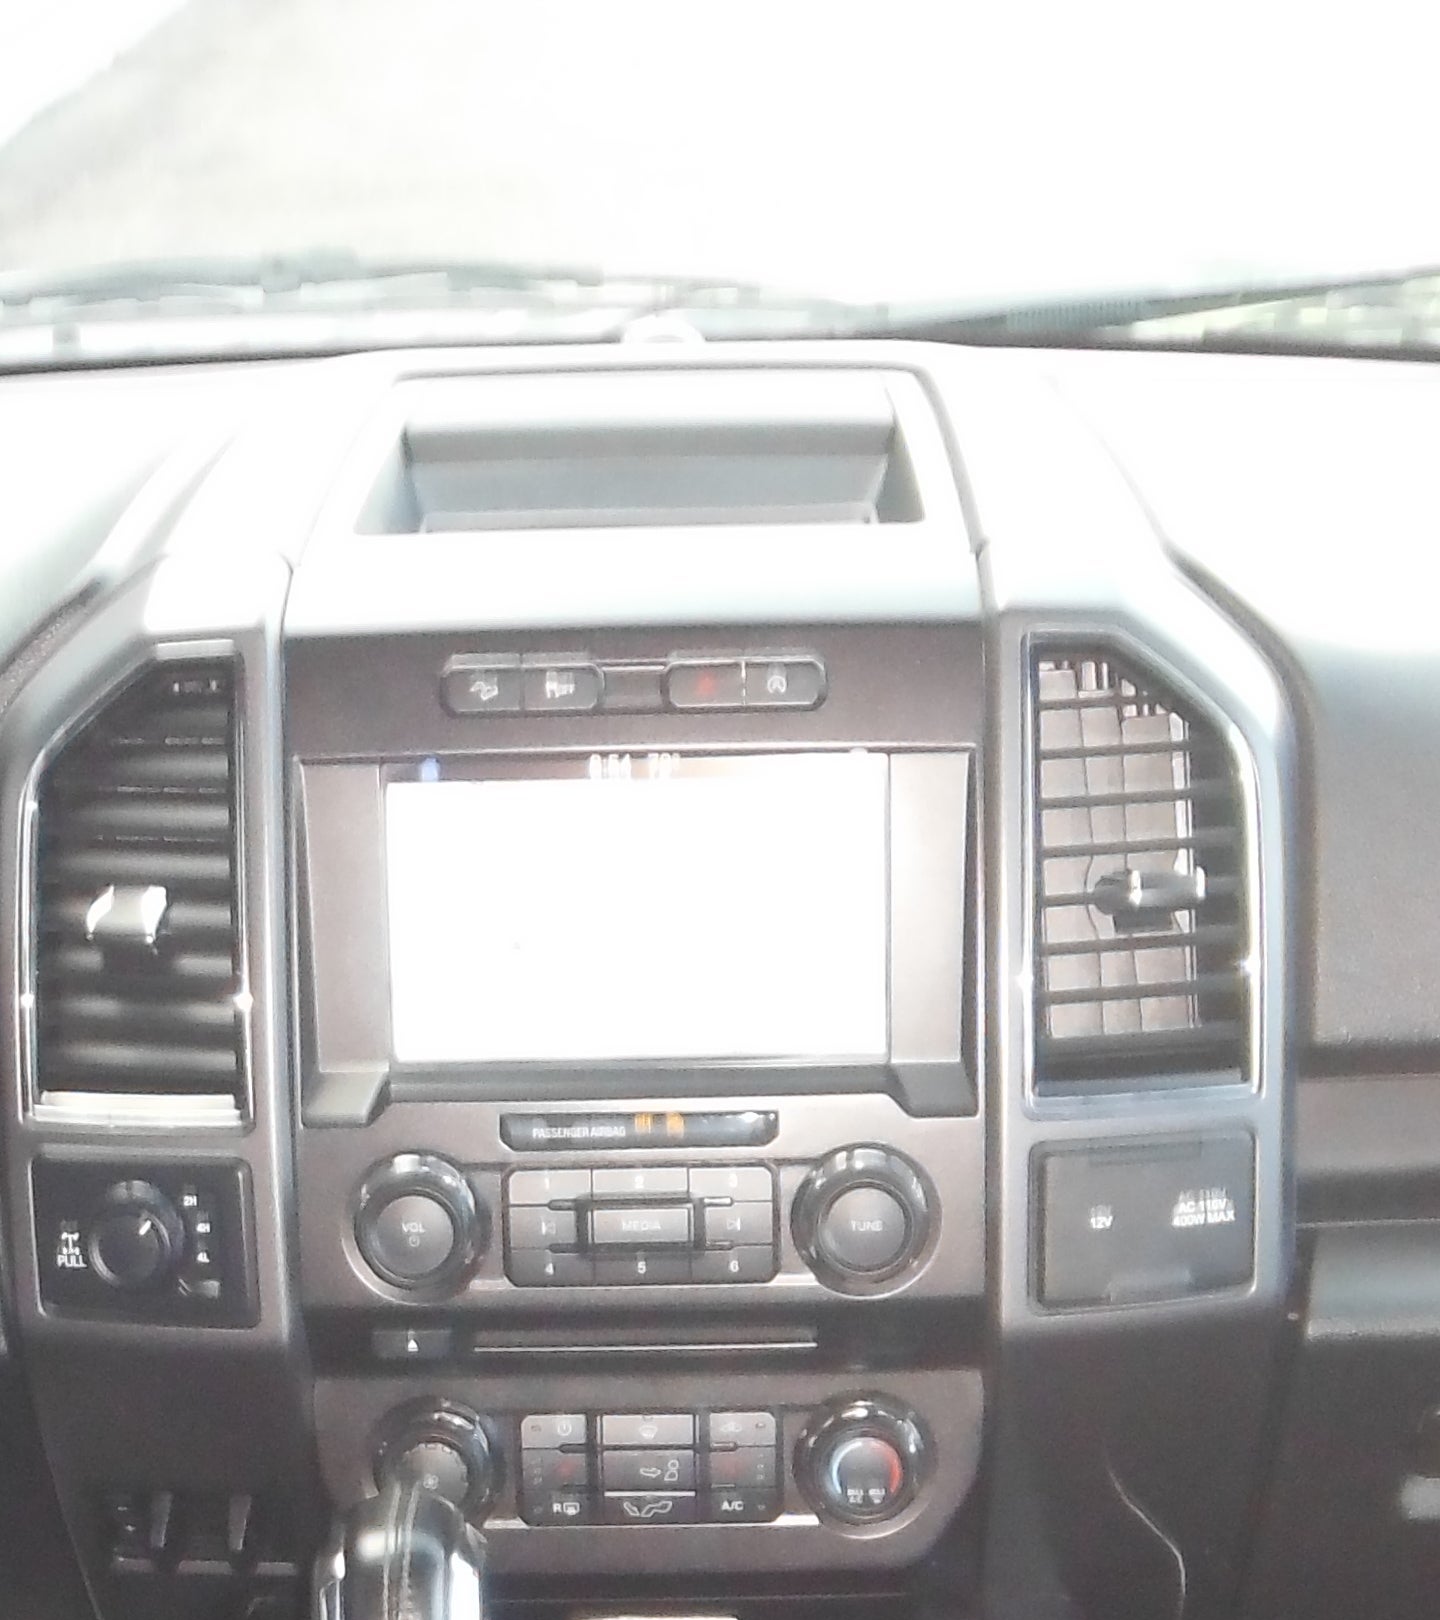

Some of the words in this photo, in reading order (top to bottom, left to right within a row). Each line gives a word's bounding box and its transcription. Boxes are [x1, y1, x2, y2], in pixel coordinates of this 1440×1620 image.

[532, 1127, 589, 1139] PASSENGER
[634, 1174, 645, 1189] 2
[1178, 1201, 1195, 1213] AC
[621, 1218, 662, 1231] MEDIA
[1090, 1215, 1113, 1229] 12V
[1172, 1213, 1205, 1227] 400W
[1207, 1210, 1235, 1223] MAX
[401, 1222, 426, 1233] VOL
[850, 1220, 883, 1231] TUNE
[57, 1255, 87, 1268] PULL
[637, 1261, 646, 1274] 5
[729, 1260, 739, 1273] 6
[545, 1262, 554, 1275] 4
[722, 1501, 743, 1511] A/C
